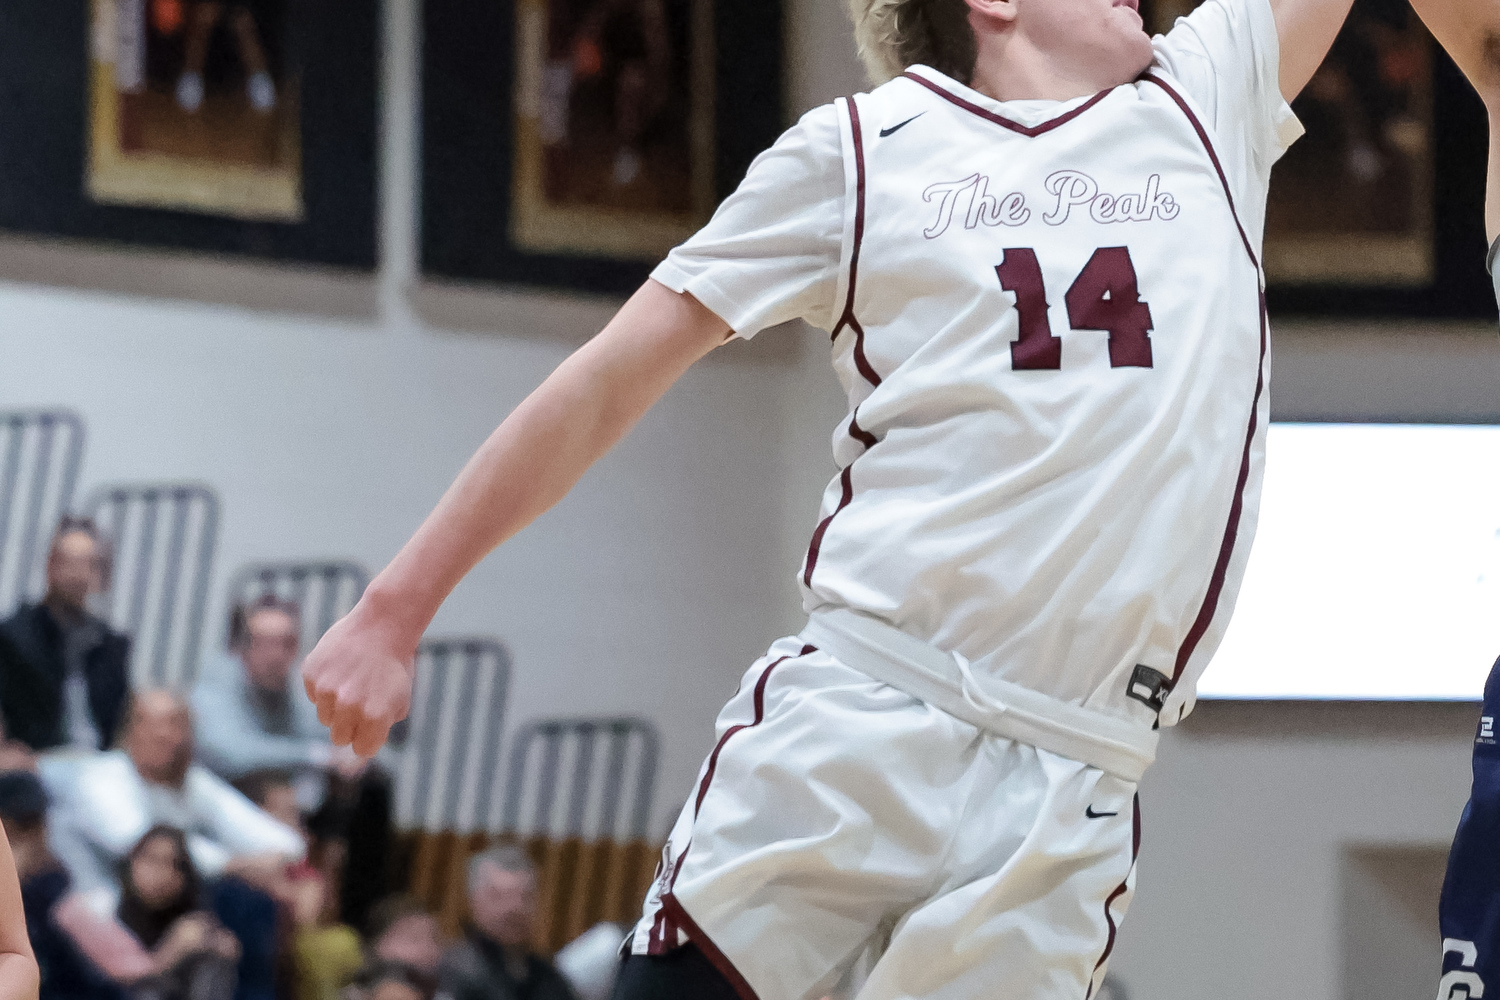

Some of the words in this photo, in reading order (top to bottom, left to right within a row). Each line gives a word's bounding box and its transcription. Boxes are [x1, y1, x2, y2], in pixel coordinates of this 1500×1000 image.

[922, 171, 1031, 240] The
[1042, 169, 1181, 227] Peak
[994, 245, 1154, 371] 14
